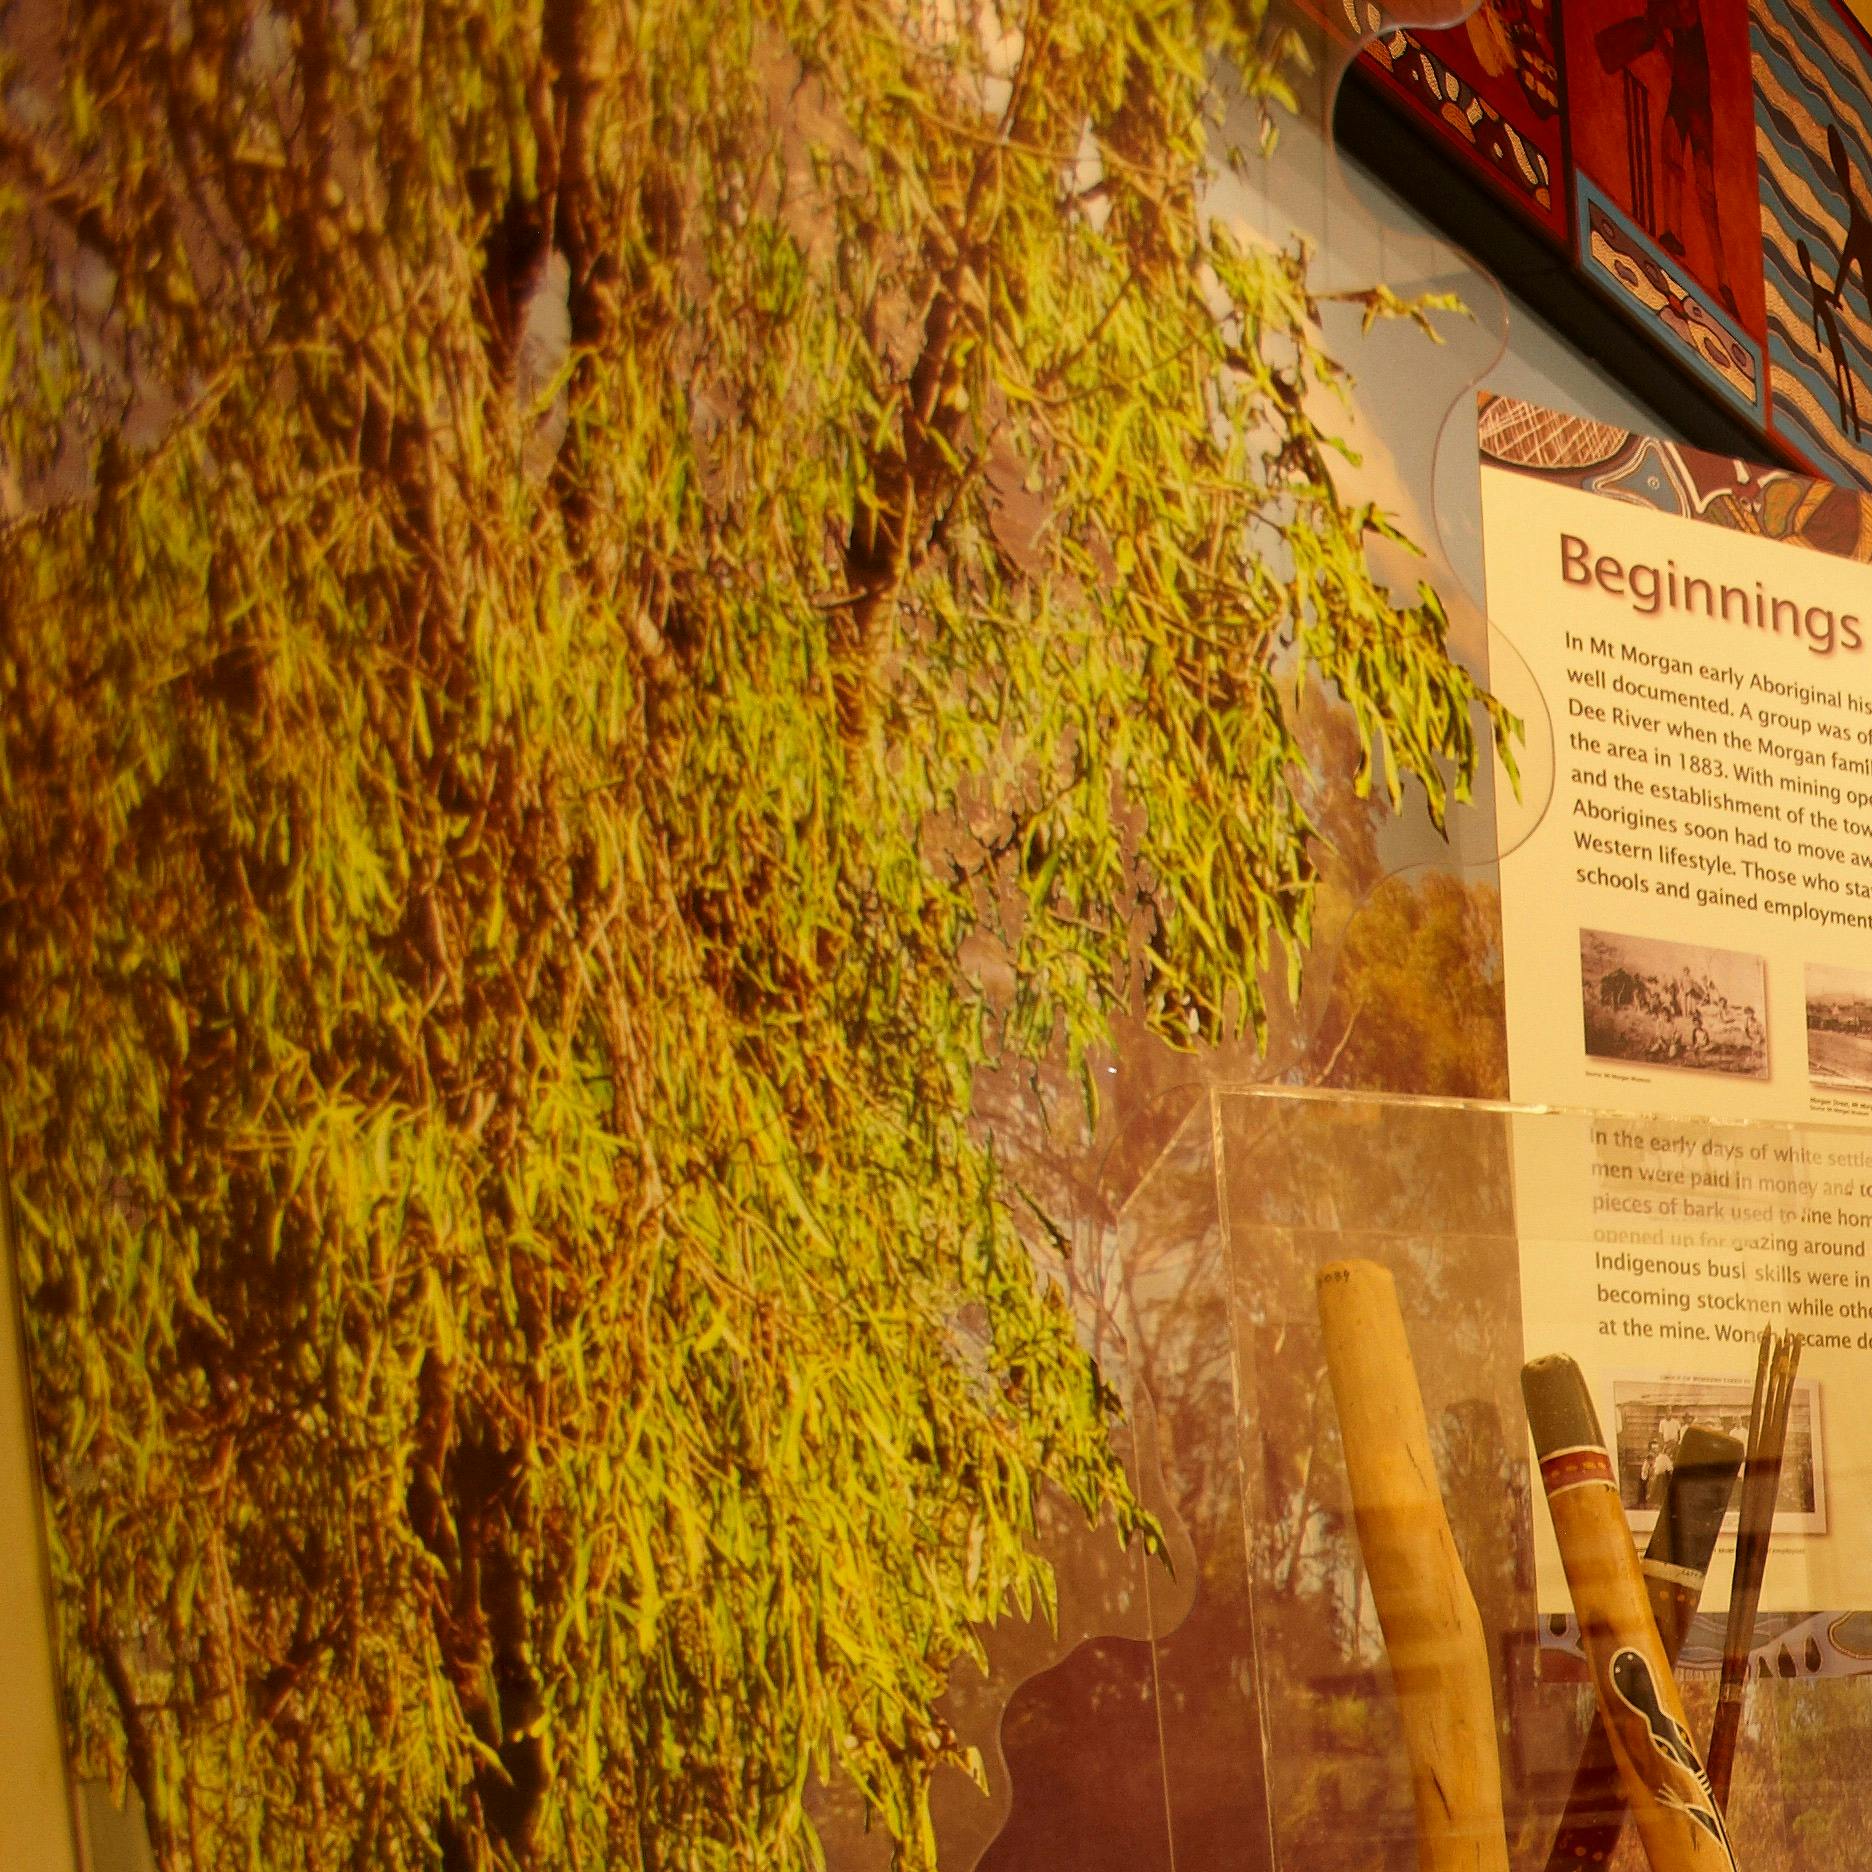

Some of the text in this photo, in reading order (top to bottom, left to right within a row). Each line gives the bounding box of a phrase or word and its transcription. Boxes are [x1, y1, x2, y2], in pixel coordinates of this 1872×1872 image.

[1560, 533, 1862, 655] Beginnings
[1566, 631, 1583, 652] In
[1591, 637, 1614, 658] Mt
[1621, 644, 1692, 675] Morgan
[1699, 666, 1744, 690] early
[1750, 674, 1841, 708] Aboriginal
[1567, 669, 1605, 689] well
[1613, 675, 1734, 717] documented.
[1740, 702, 1752, 720] A
[1758, 710, 1811, 735] group
[1817, 723, 1851, 741] was
[1569, 698, 1606, 722] Dee
[1613, 707, 1661, 732] River
[1667, 721, 1717, 744] when
[1723, 730, 1752, 752] the
[1758, 738, 1825, 766] Morgan
